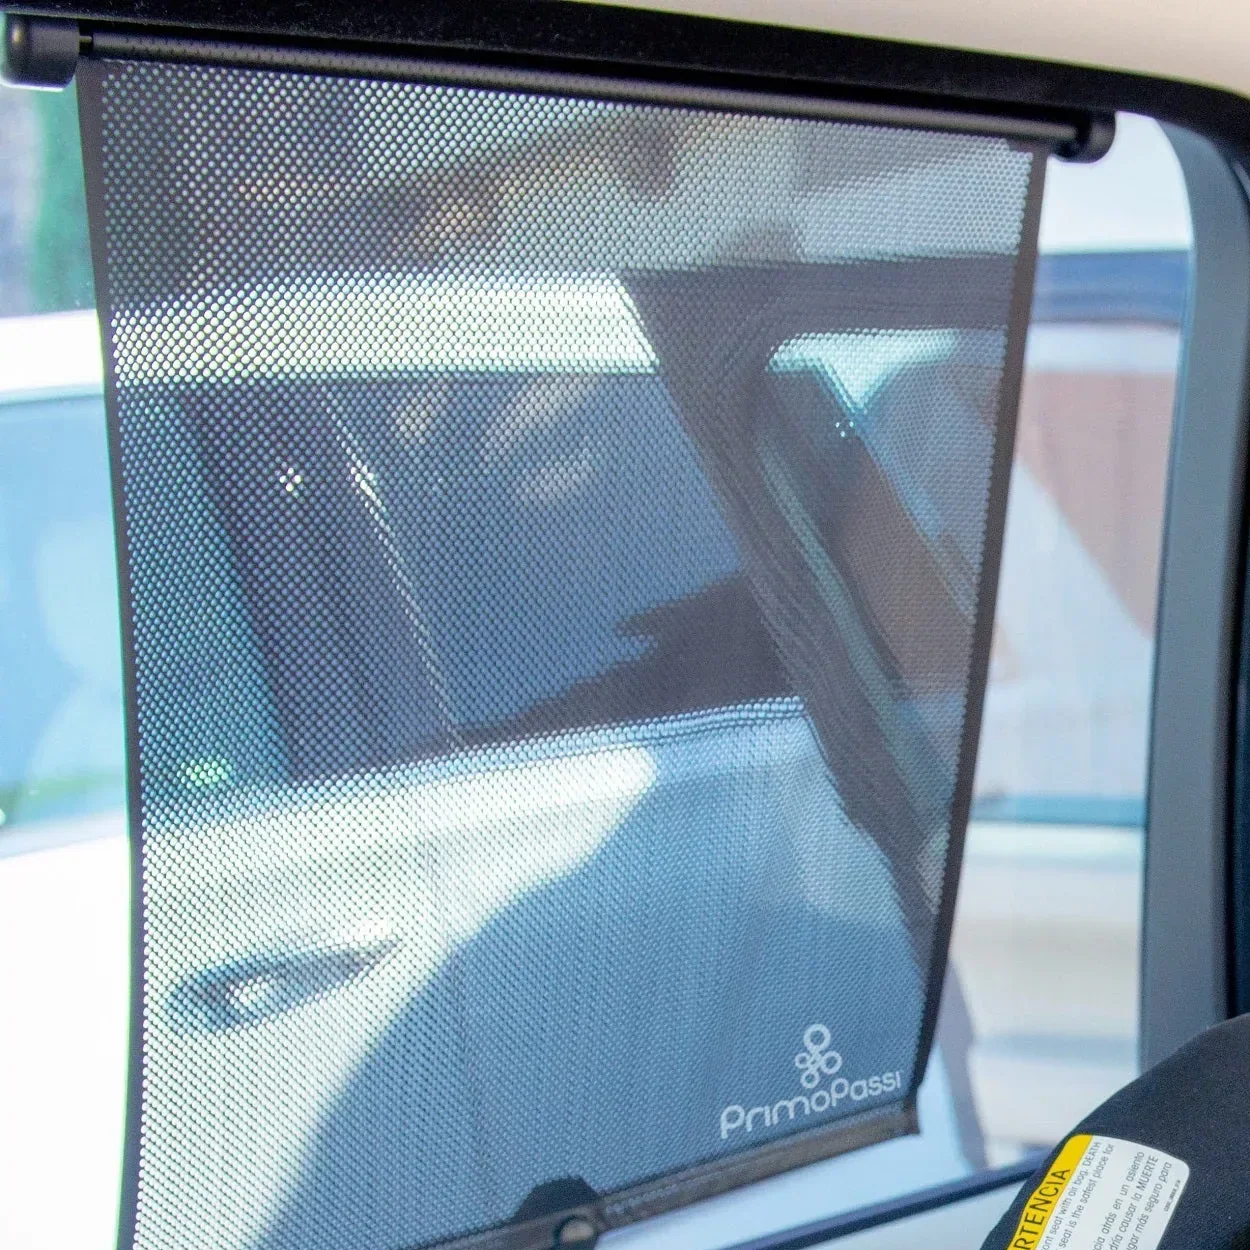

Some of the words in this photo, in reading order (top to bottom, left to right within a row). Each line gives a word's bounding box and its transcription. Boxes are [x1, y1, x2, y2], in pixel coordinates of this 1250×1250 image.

[1091, 1154, 1110, 1180] place
[1134, 1154, 1160, 1192] MUERTE
[1048, 1215, 1064, 1235] seat
[1057, 1196, 1073, 1215] with
[1067, 1185, 1078, 1197] air
[1081, 1140, 1102, 1167] DEATH
[1078, 1178, 1097, 1204] safest
[1100, 1211, 1117, 1235] atrás
[1112, 1197, 1124, 1210] en
[1118, 1183, 1130, 1196] un
[1124, 1150, 1146, 1183] asiento
[1130, 1191, 1143, 1202] la
[1133, 1212, 1150, 1234] más
[1143, 1182, 1164, 1213] seguro
[1157, 1161, 1174, 1184] para
[1066, 1218, 1078, 1229] is
[1070, 1203, 1085, 1219] the
[1117, 1201, 1138, 1233] causar
[1057, 1228, 1073, 1249] seat
